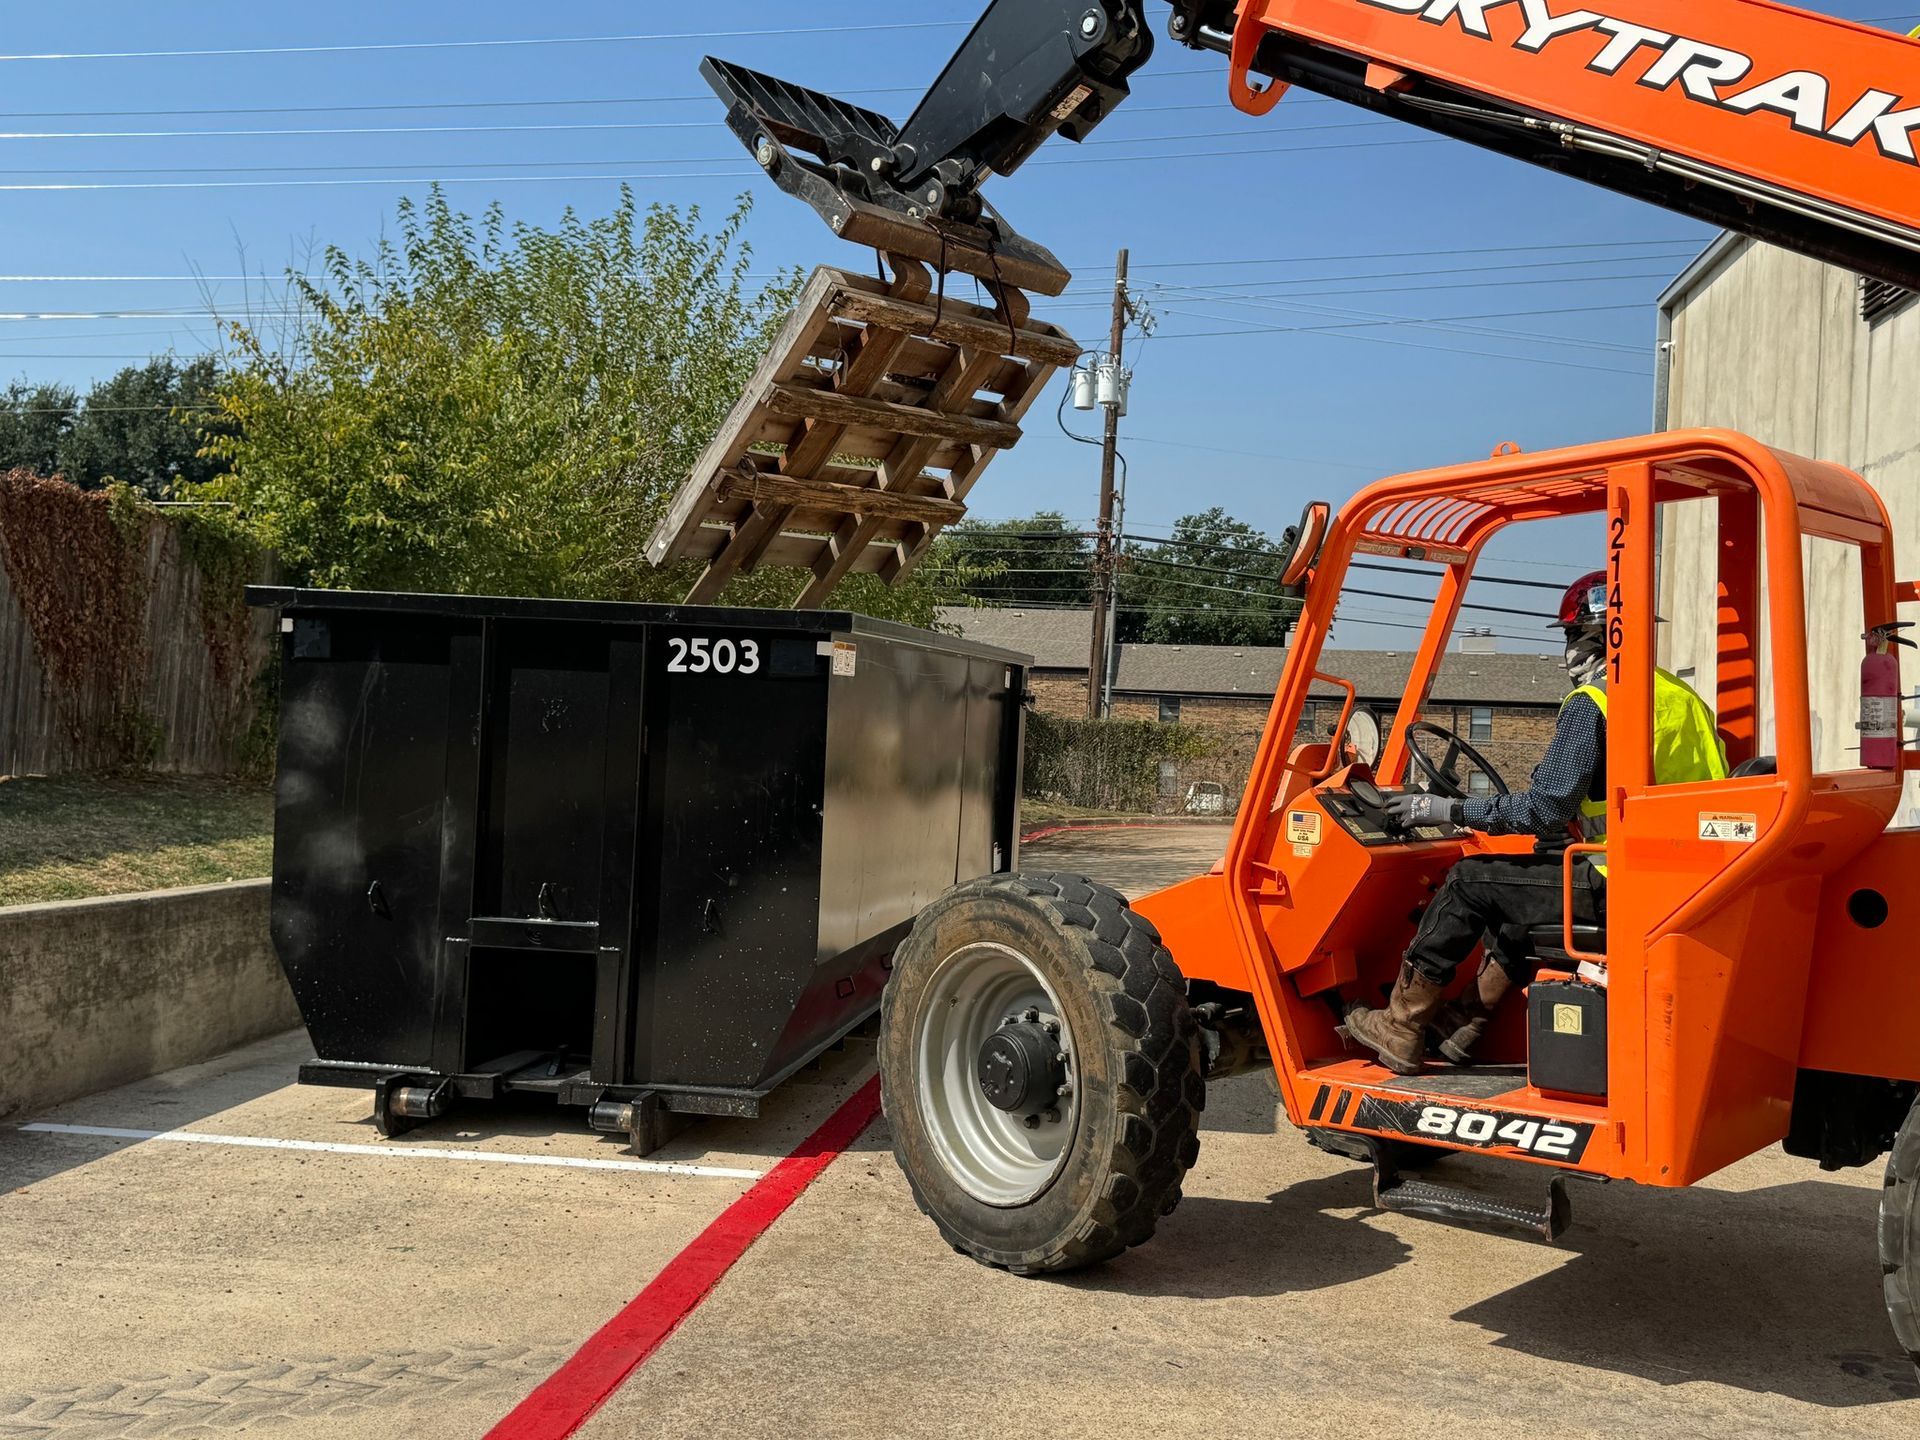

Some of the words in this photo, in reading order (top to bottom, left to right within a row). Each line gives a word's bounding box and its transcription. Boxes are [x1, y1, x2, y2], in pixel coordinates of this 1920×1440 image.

[1608, 517, 1625, 684] 21461
[667, 637, 760, 674] 2503
[1416, 1106, 1577, 1156] 8042
